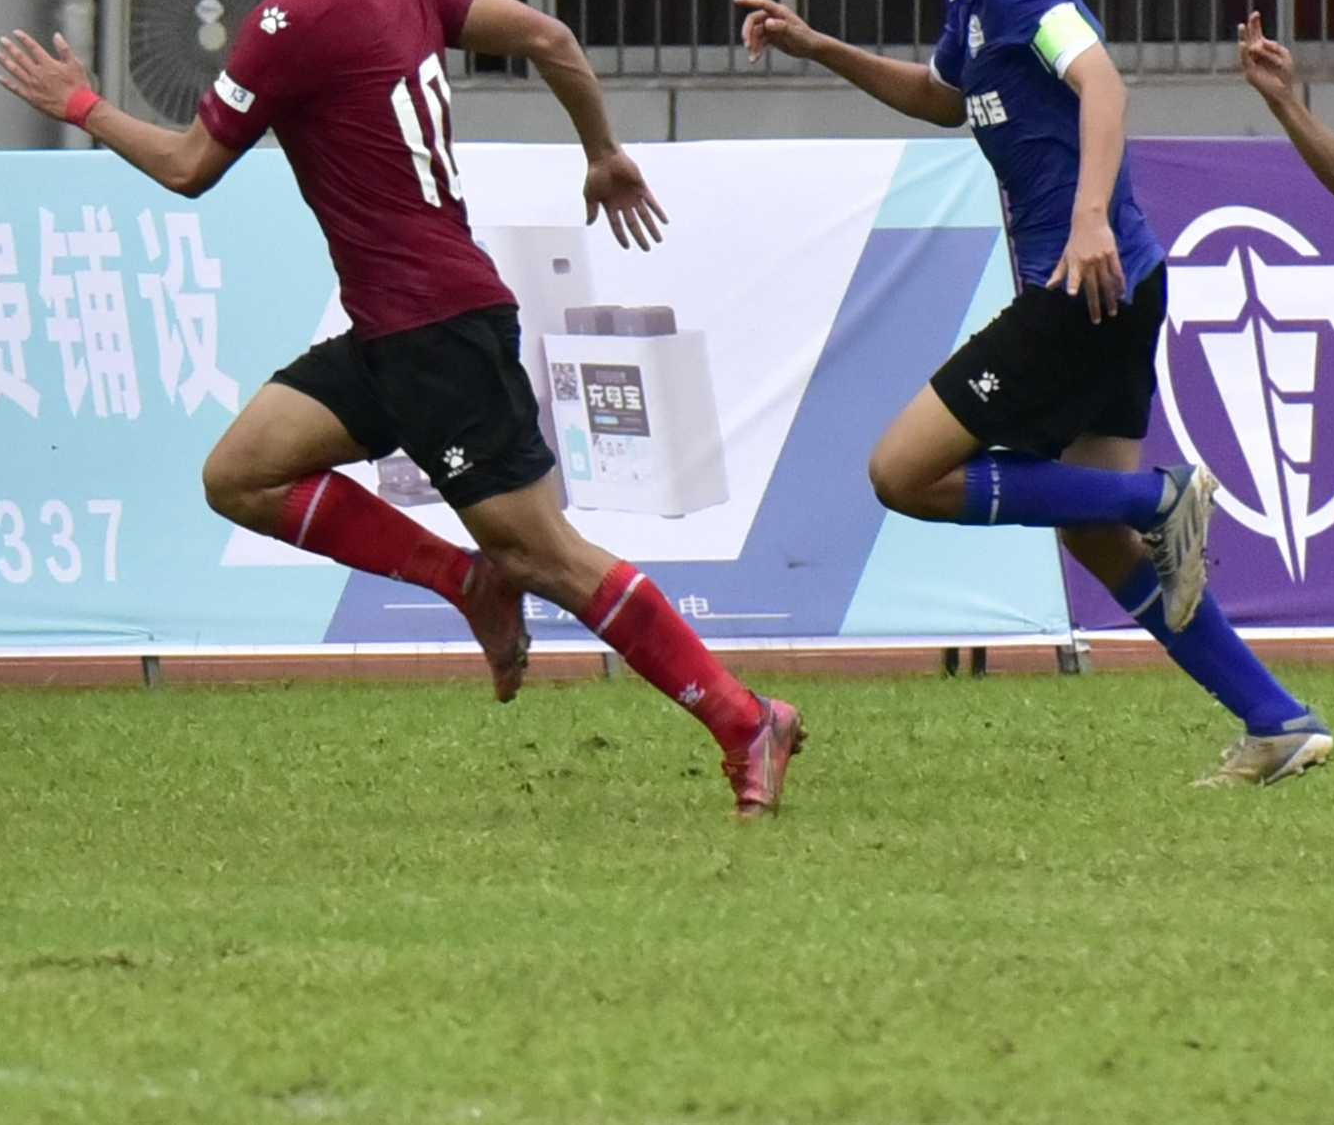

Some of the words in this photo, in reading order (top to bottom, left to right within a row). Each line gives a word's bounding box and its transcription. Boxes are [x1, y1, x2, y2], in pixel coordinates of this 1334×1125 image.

[390, 52, 464, 208] 10
[586, 384, 643, 411] 充电宝
